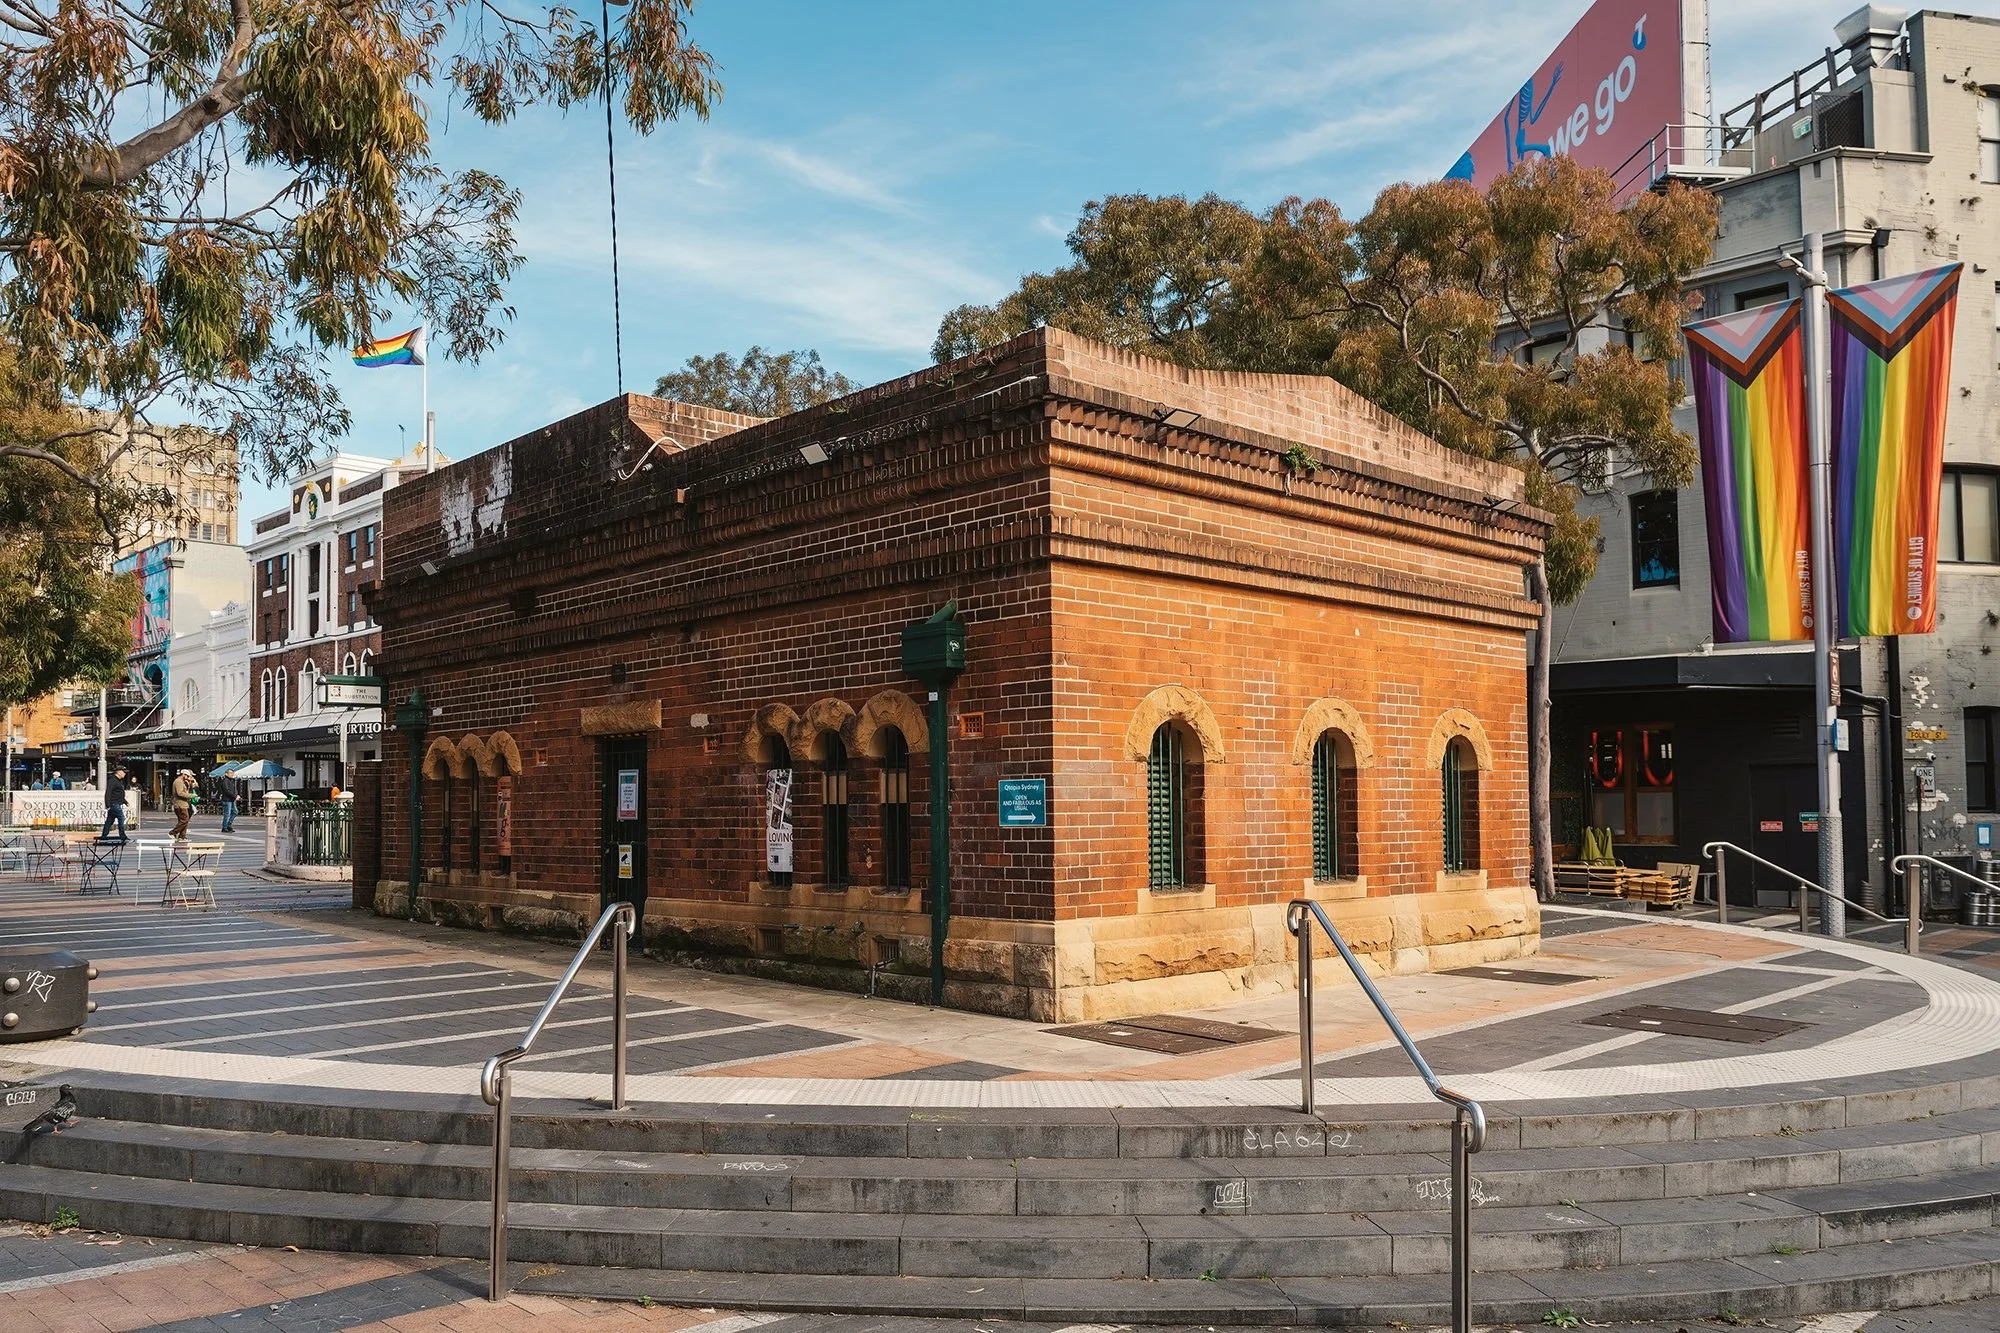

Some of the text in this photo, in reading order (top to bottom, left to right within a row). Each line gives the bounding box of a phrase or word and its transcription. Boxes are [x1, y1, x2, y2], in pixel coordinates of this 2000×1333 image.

[1547, 55, 1636, 158] we go
[1795, 550, 1812, 614] CITY OF SYDNEY
[1907, 536, 1924, 604] CITY OF SYDNEY
[226, 738, 232, 746] IN
[233, 735, 253, 746] SESSION
[254, 733, 269, 744] SINCE
[24, 801, 76, 810] OXFORD
